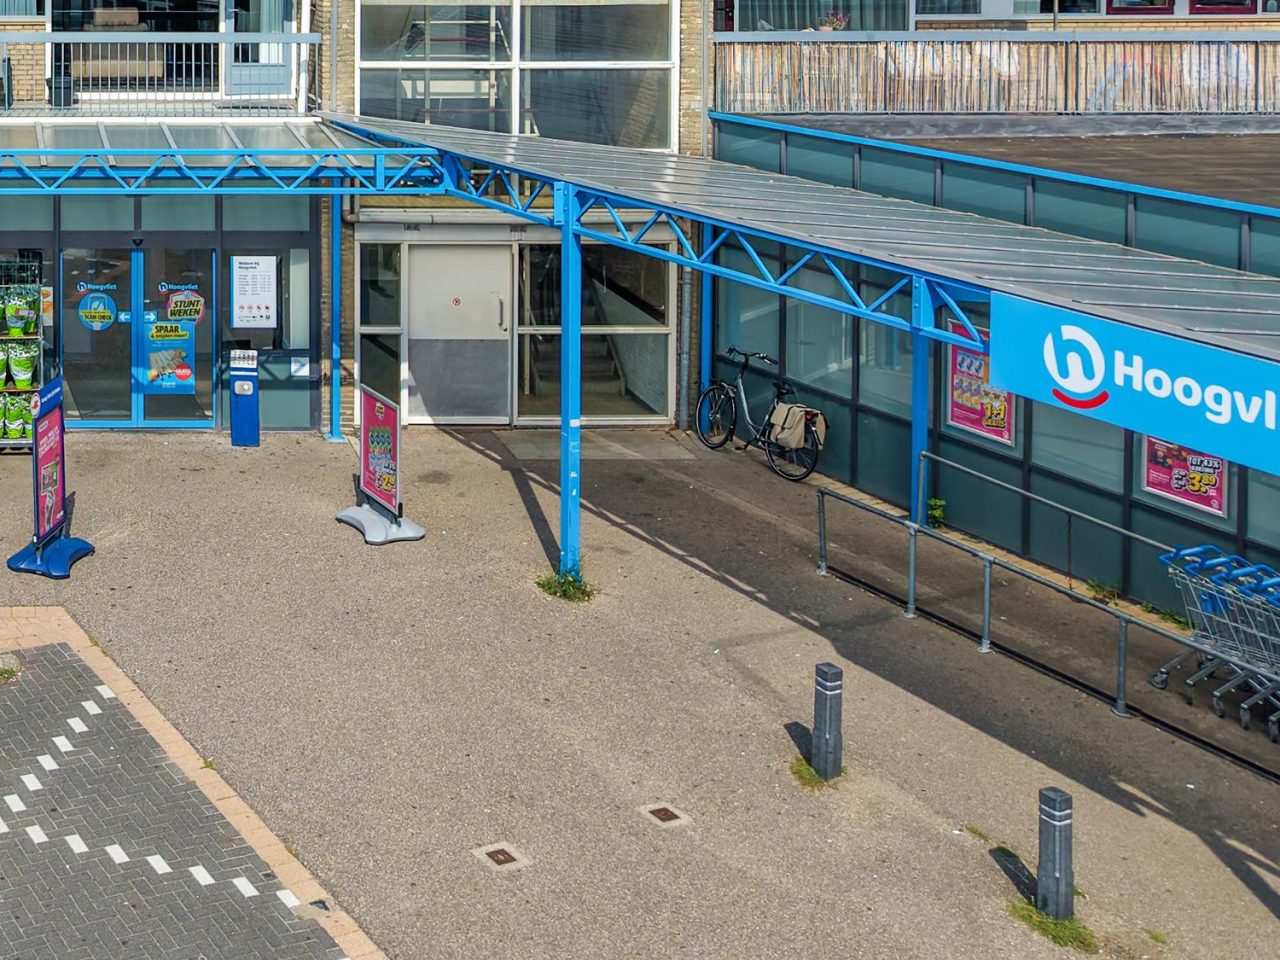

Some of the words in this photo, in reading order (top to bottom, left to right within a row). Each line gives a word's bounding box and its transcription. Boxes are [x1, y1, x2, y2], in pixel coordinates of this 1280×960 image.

[87, 283, 117, 291] Hoogvliet
[168, 283, 198, 291] Hoogvliet
[173, 299, 201, 309] STUNT
[169, 308, 201, 318] WEKEN
[154, 325, 180, 334] SPAAR
[985, 401, 1006, 420] 1+1
